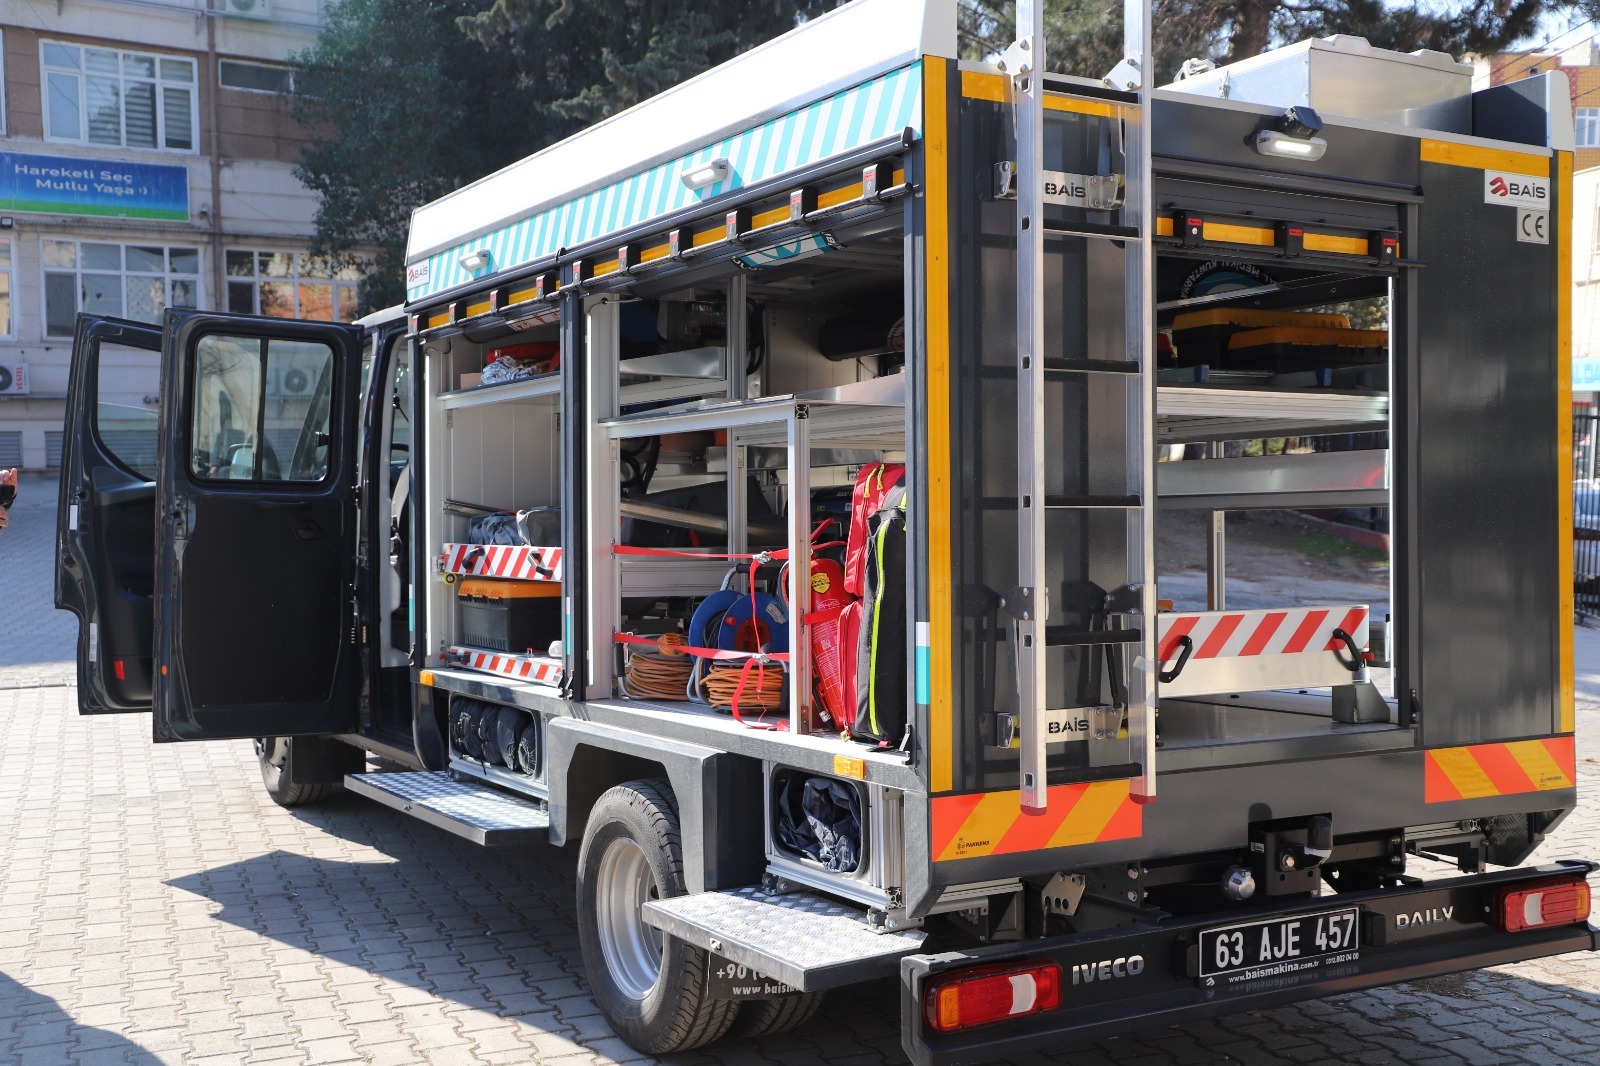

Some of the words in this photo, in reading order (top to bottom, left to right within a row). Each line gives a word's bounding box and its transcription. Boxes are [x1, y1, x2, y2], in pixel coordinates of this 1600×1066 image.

[14, 164, 95, 179] Hareketi
[99, 171, 133, 184] Seç
[35, 178, 88, 192] Mutlu
[93, 182, 135, 196] Yaşa
[1521, 213, 1545, 239] CE
[1395, 906, 1454, 930] DAILY
[1215, 931, 1244, 968] 63
[1259, 921, 1301, 962] AJE
[1315, 913, 1355, 951] 457
[716, 963, 747, 980] +90
[1072, 954, 1145, 986] IVECO
[1228, 960, 1320, 983] www.baismakina.com.tr
